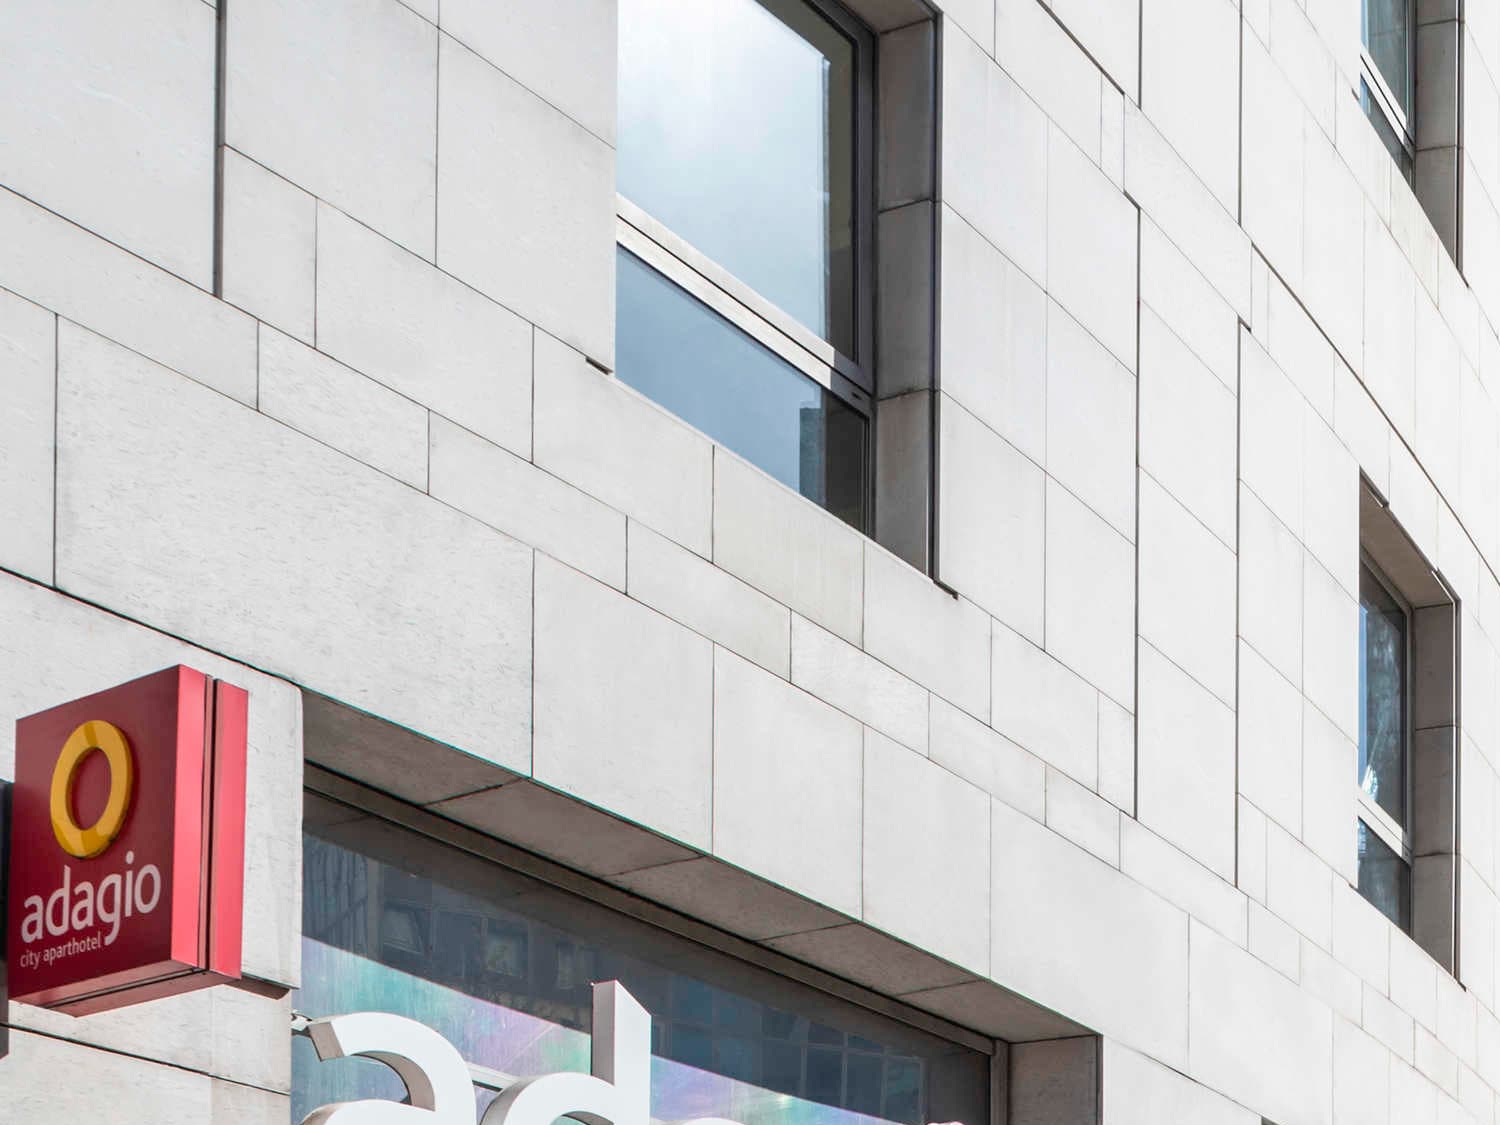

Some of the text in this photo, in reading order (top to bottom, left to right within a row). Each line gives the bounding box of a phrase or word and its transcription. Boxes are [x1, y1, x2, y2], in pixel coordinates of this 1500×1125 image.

[21, 851, 161, 946] adagio
[20, 931, 101, 970] city aparthotel
